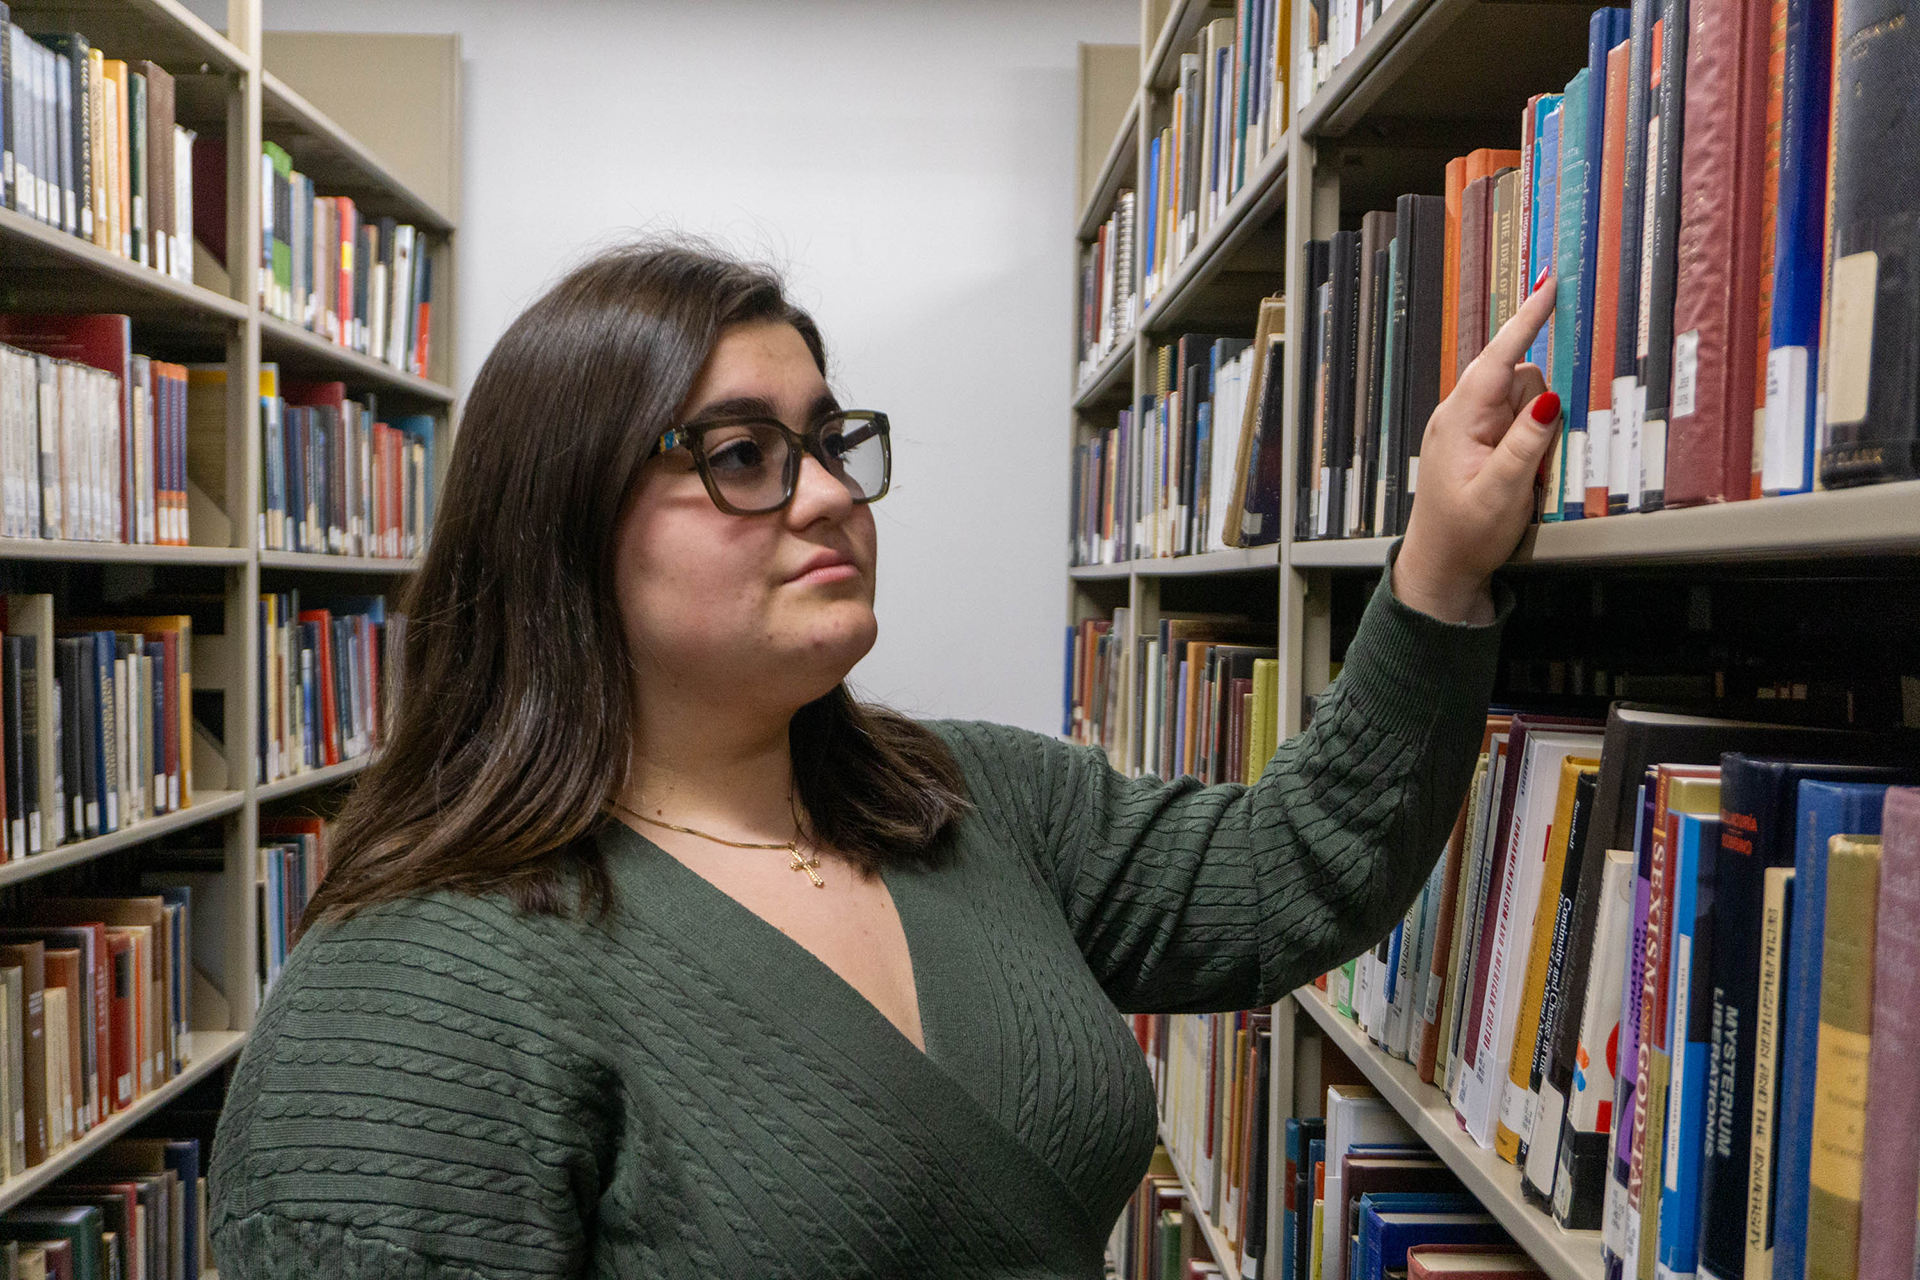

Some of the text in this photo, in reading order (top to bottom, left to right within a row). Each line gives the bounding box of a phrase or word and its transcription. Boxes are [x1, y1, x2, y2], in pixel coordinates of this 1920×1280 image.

[1582, 161, 1590, 192] God
[1500, 210, 1510, 242] THE
[1521, 211, 1529, 254] THOUGHT:
[1645, 192, 1654, 258] INQUIRY
[1499, 242, 1509, 275] IDEA
[1576, 257, 1585, 313] Natural
[1499, 278, 1507, 295] OF
[1573, 319, 1581, 366] World
[1569, 798, 1580, 850] Snowball
[1470, 839, 1484, 912] CHRISTIAN
[1501, 815, 1522, 921] FUNDAMENTALISM
[1497, 921, 1507, 947] AND
[1552, 891, 1565, 947] Rhetoric
[1553, 897, 1572, 966] Continuity
[1643, 841, 1664, 996] SEXISM
[1399, 918, 1413, 978] CHRISTIAN
[1488, 947, 1503, 1008] AMERICAN
[1539, 982, 1551, 1019] Moral
[1549, 966, 1560, 992] and
[1557, 965, 1576, 1037] Handbook
[1627, 927, 1641, 1027] QUESTION
[1632, 920, 1648, 1049] THE FEMINIST
[1483, 1008, 1495, 1050] CULTUR
[1543, 992, 1558, 1036] Change
[1642, 999, 1652, 1036] AND
[1530, 1019, 1545, 1073] Majority
[1538, 1054, 1548, 1075] the
[1541, 1039, 1550, 1050] in
[1704, 987, 1723, 1158] LIBERATIONIS
[1716, 1004, 1739, 1158] MYSTERIUM
[1628, 1041, 1651, 1210] GOD-TAL
